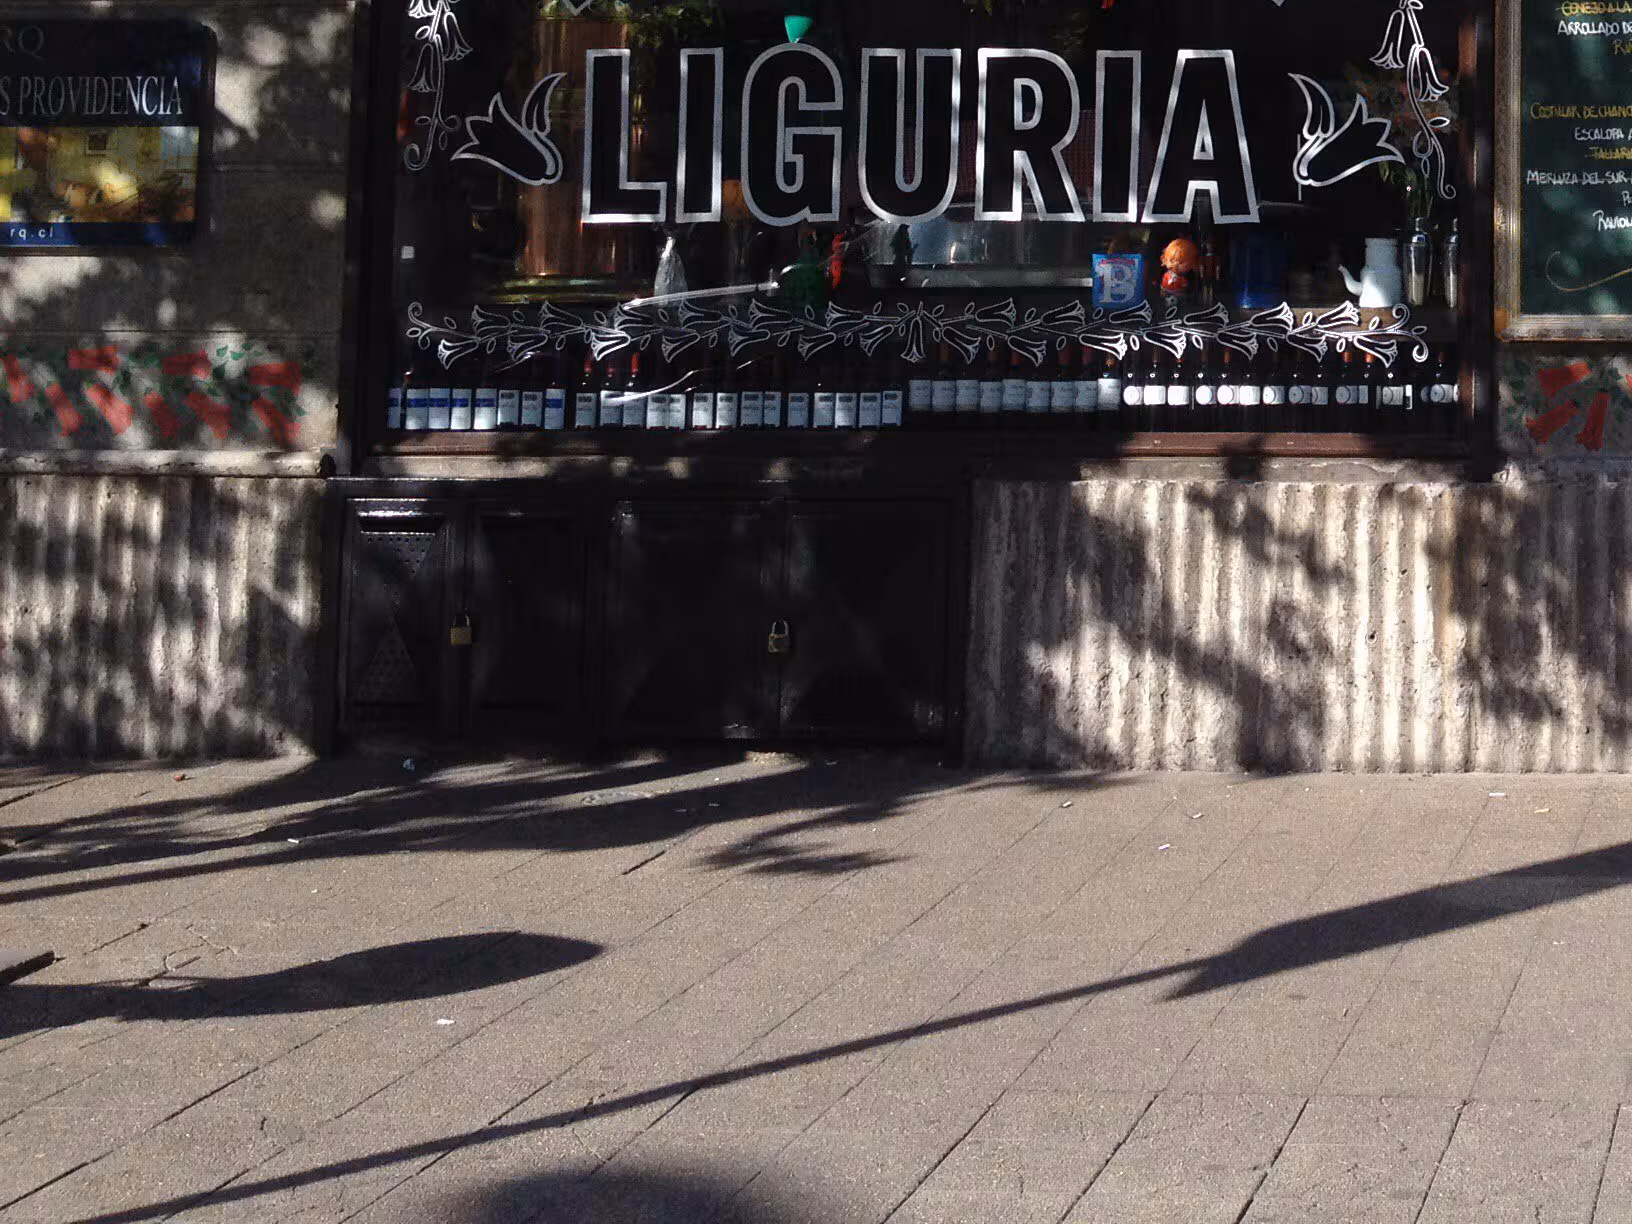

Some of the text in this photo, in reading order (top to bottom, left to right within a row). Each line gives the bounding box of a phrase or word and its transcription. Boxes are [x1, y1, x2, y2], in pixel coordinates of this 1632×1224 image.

[1557, 19, 1620, 36] ARROLLADO
[18, 76, 183, 116] PROVIDENCIA
[1583, 105, 1598, 118] DE
[580, 41, 1262, 227] LIGURIA
[1575, 127, 1624, 141] ESCALOPA
[1526, 170, 1578, 185] MERLUZA
[1582, 171, 1604, 184] DEL
[1605, 170, 1628, 183] SUR
